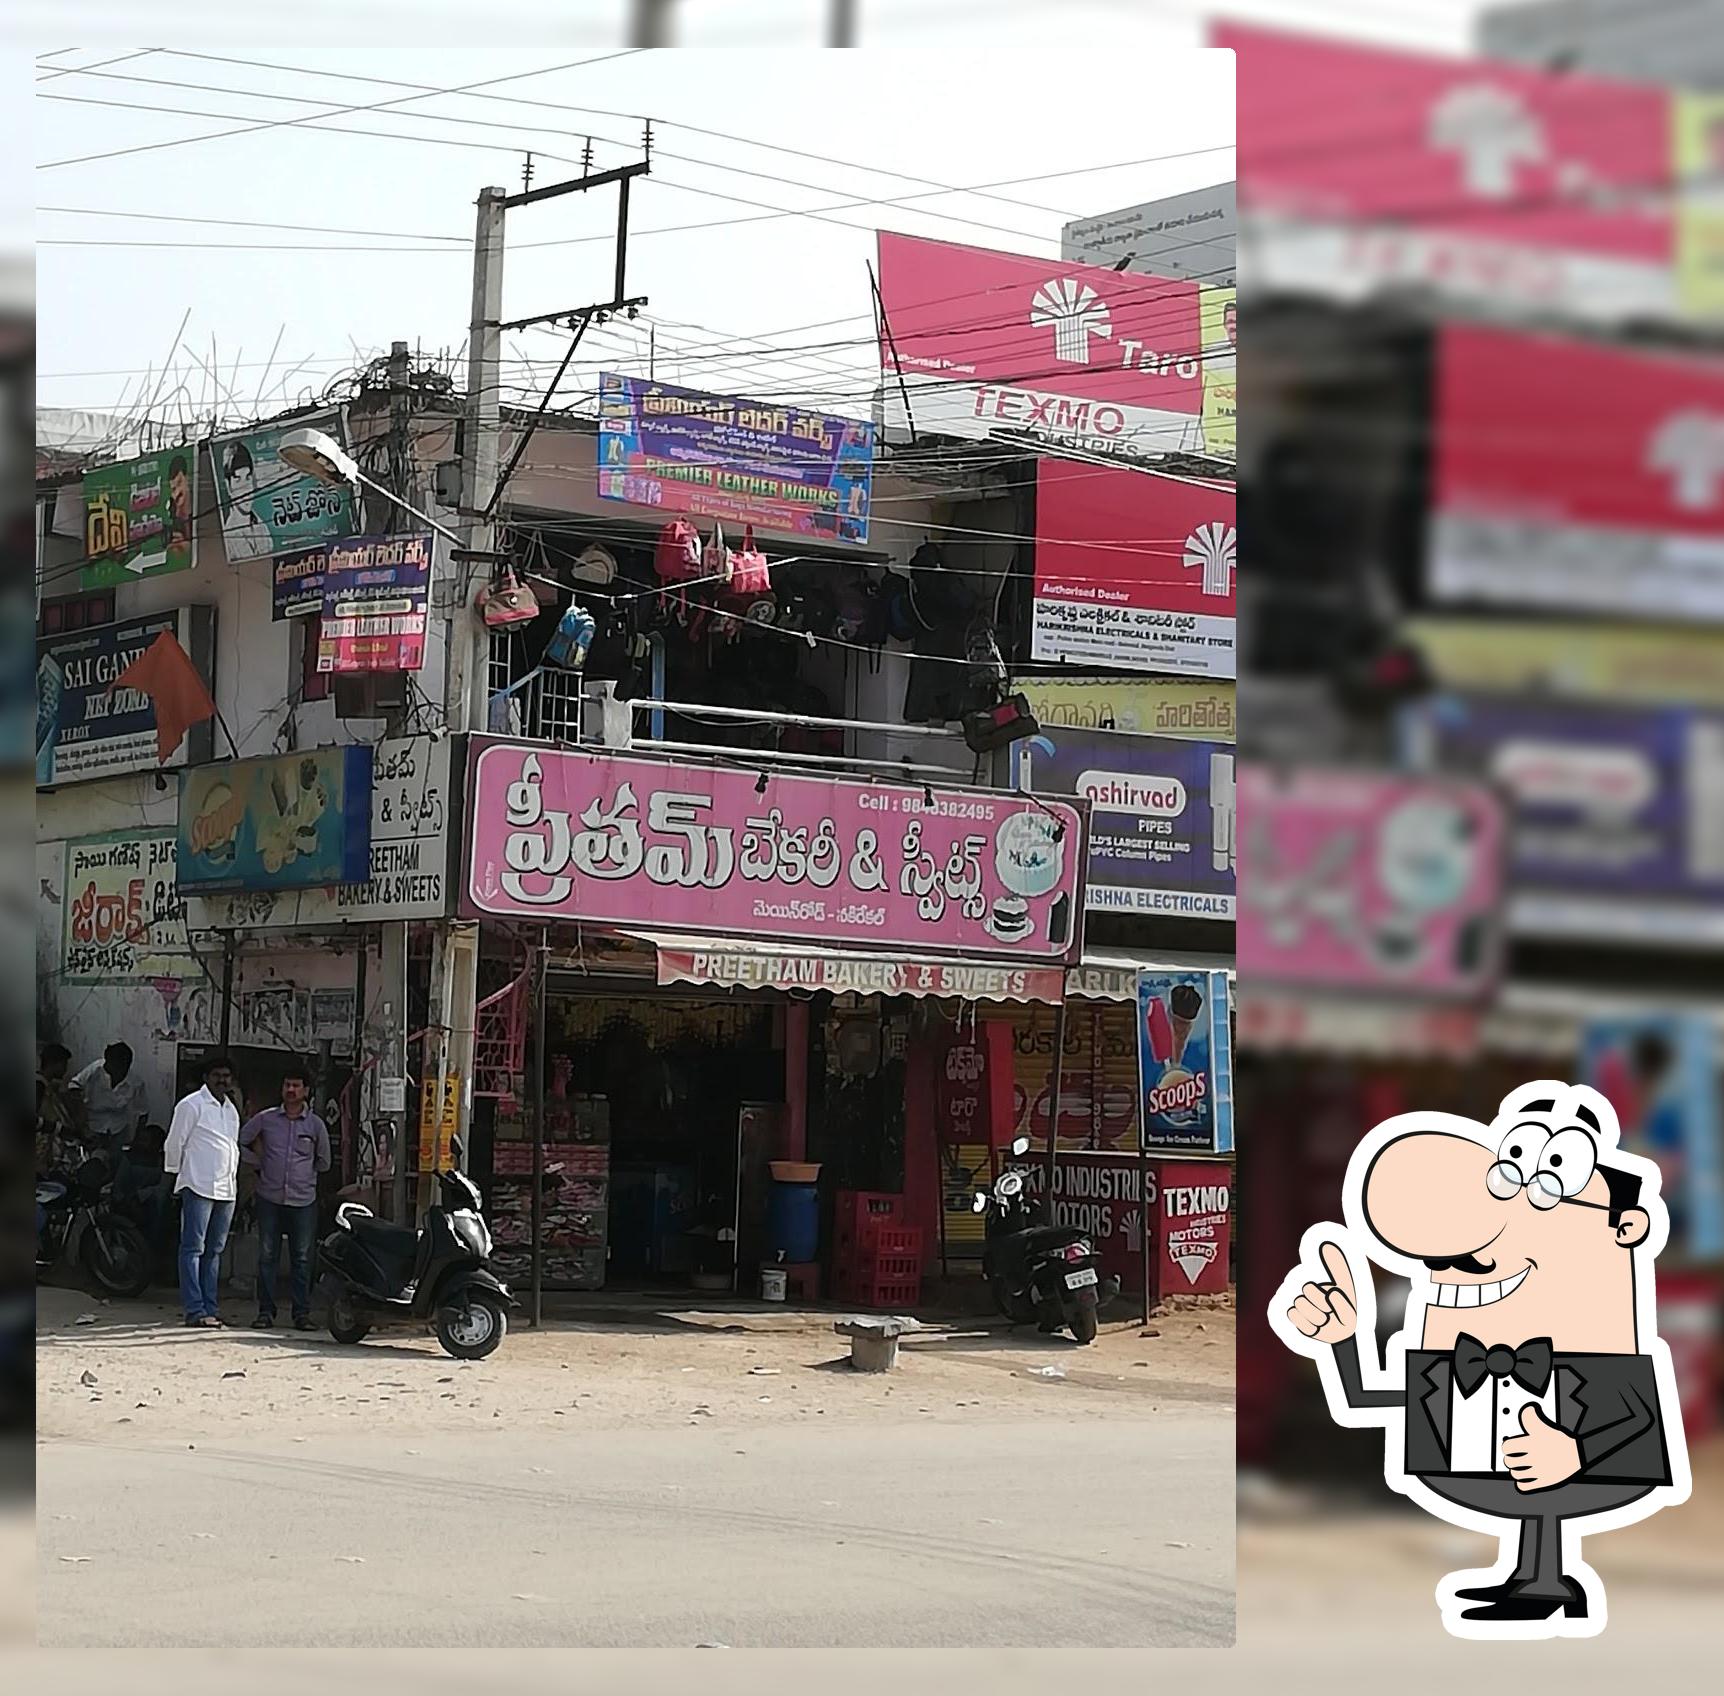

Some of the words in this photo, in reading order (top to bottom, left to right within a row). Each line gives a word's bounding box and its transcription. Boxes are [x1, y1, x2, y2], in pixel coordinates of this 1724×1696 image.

[1118, 338, 1198, 379] Taro
[975, 387, 1124, 436] TEXMO
[646, 457, 712, 486] PREMIER
[717, 471, 778, 498] LEATHER
[782, 482, 838, 507] WORKS
[1042, 583, 1095, 598] Authorised
[1098, 588, 1130, 601] Dealer
[64, 658, 92, 690] SAI
[60, 725, 91, 743] XEROX
[859, 793, 889, 811] Cell
[1086, 781, 1177, 809] ashirvad
[381, 798, 392, 823] &
[500, 752, 734, 905] ప్రీతమ్
[740, 807, 842, 888] బేకరీ
[849, 828, 889, 891] &
[900, 820, 987, 921] స్వీట్స్
[1138, 820, 1172, 834] PIPES
[1114, 837, 1152, 850] LARGEST
[1154, 840, 1190, 852] SELLING
[75, 851, 107, 878] సాయి
[383, 877, 392, 904] &
[394, 874, 440, 904] SWEETS
[1137, 893, 1229, 913] ELECTRICALS
[693, 953, 817, 983] PREETHAM
[918, 965, 933, 989] &
[1163, 1186, 1229, 1217] TEXMO
[1169, 1226, 1214, 1242] MOTORS
[1174, 1245, 1212, 1257] TEXMO
